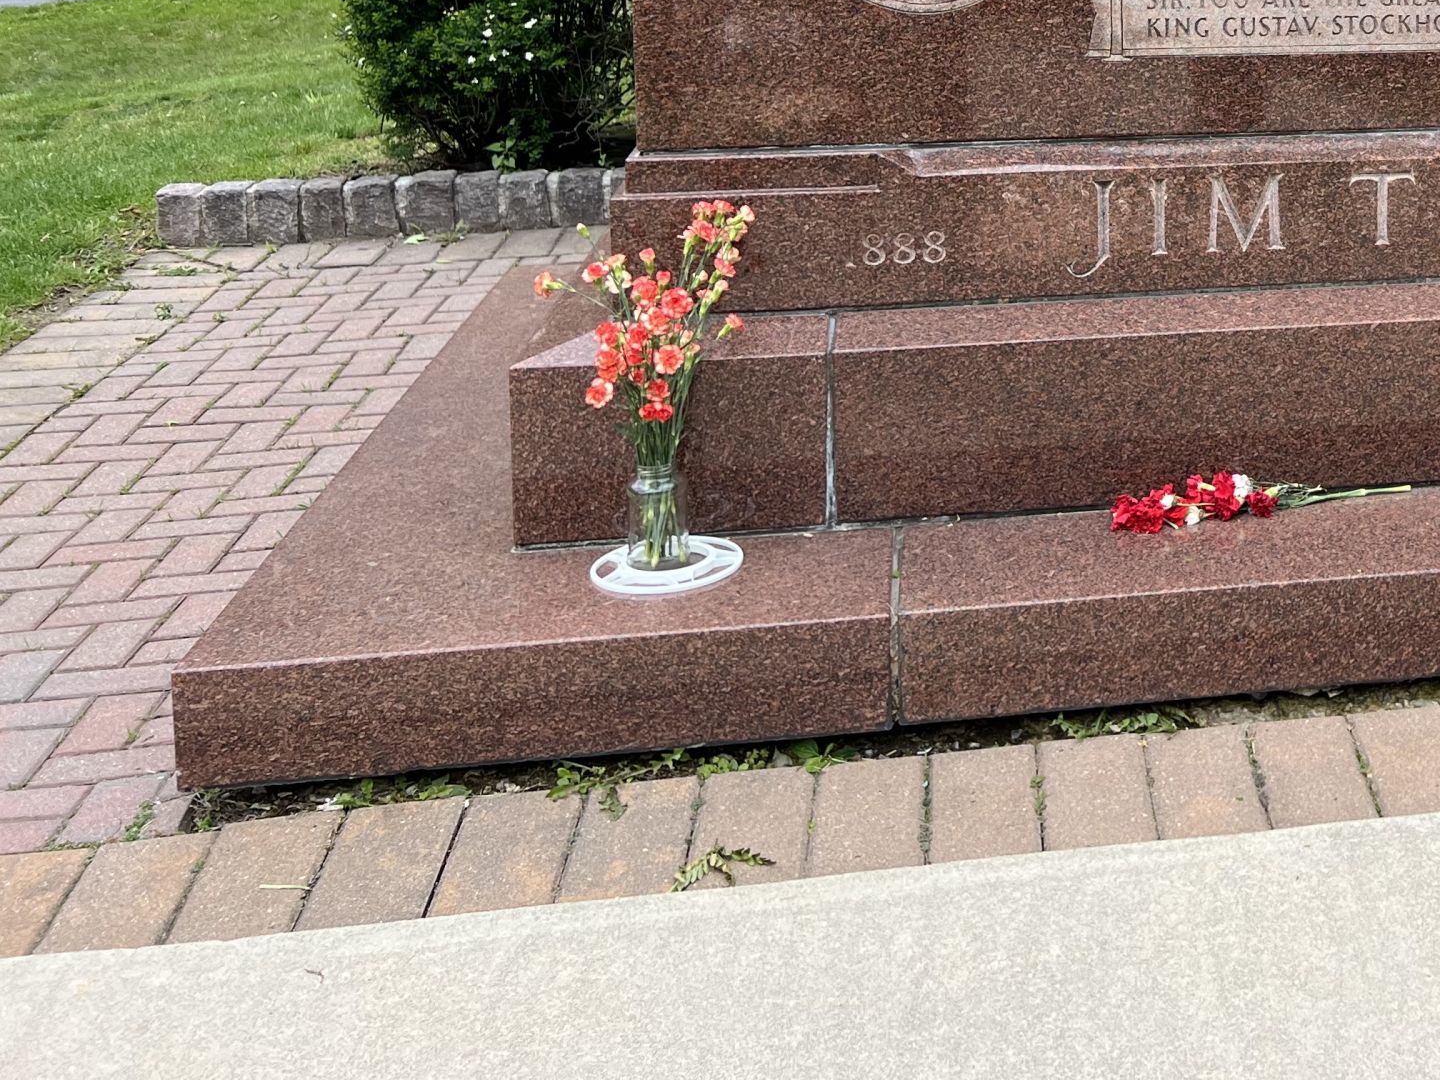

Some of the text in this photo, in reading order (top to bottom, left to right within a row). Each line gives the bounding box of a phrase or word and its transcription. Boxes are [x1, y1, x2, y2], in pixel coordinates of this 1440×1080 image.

[1146, 18, 1209, 38] KING
[1065, 173, 1286, 279] JIM
[845, 230, 947, 268] 888
